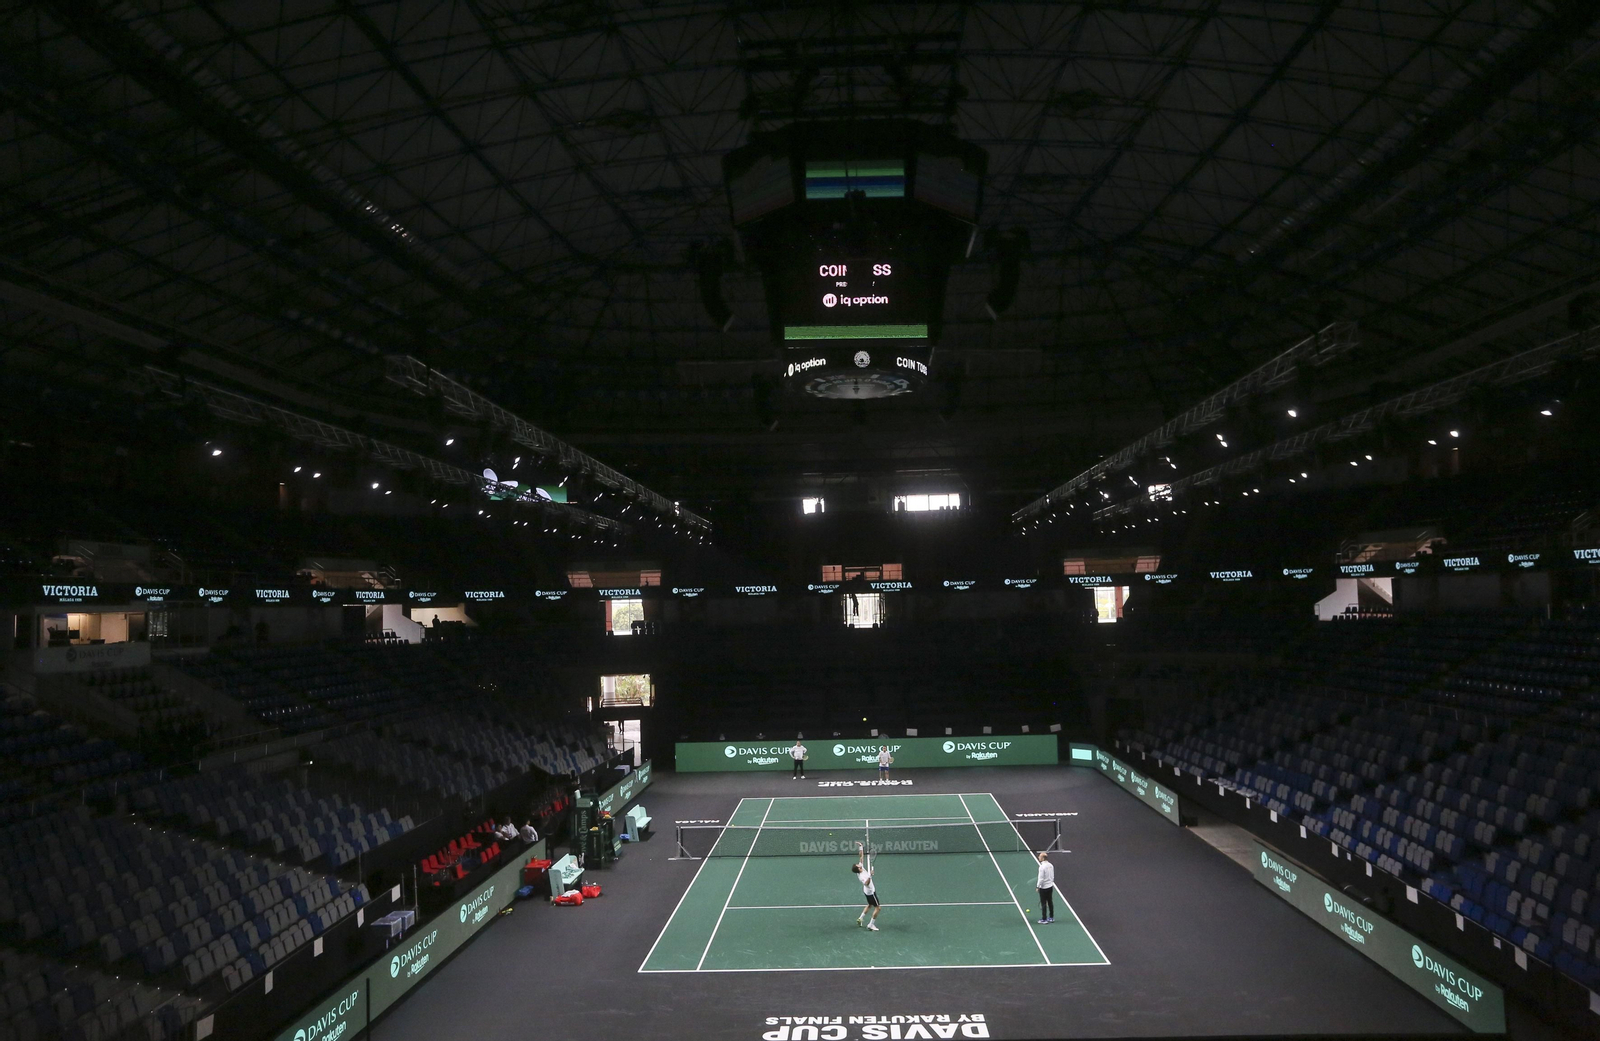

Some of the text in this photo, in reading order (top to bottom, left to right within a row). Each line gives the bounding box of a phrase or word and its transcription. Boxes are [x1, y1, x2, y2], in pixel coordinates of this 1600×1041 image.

[872, 263, 892, 276] SS
[840, 294, 888, 306] iq option
[801, 357, 826, 371] option
[896, 356, 915, 371] COIN
[1443, 557, 1480, 567] VICTORIA
[1210, 570, 1253, 578] VICTORIA
[1340, 564, 1374, 573] VICTORIA
[42, 585, 98, 596] VICTORIA
[255, 589, 290, 598] VICTORIA
[739, 746, 790, 755] DAVIS CUP
[847, 746, 876, 754] DAVIS
[988, 742, 1010, 750] CUP
[862, 755, 878, 763] Raku
[800, 841, 838, 852] DAVIS
[871, 842, 883, 852] by
[886, 840, 938, 851] RAKUTEN
[1268, 858, 1297, 884] DAVIS CUP
[468, 885, 494, 914] DAVIS CUP
[1334, 902, 1374, 934] DAVIS CUP
[401, 930, 437, 968] DAVIS CUP
[411, 954, 430, 974] Rakuten
[1425, 956, 1482, 1001] DAVIS CUP
[1440, 983, 1469, 1012] Rakuten
[308, 991, 358, 1041] DAVIS CUP
[765, 1014, 986, 1026] BY RAKUTEN FINALS
[762, 1022, 990, 1041] DAVIS CUP
